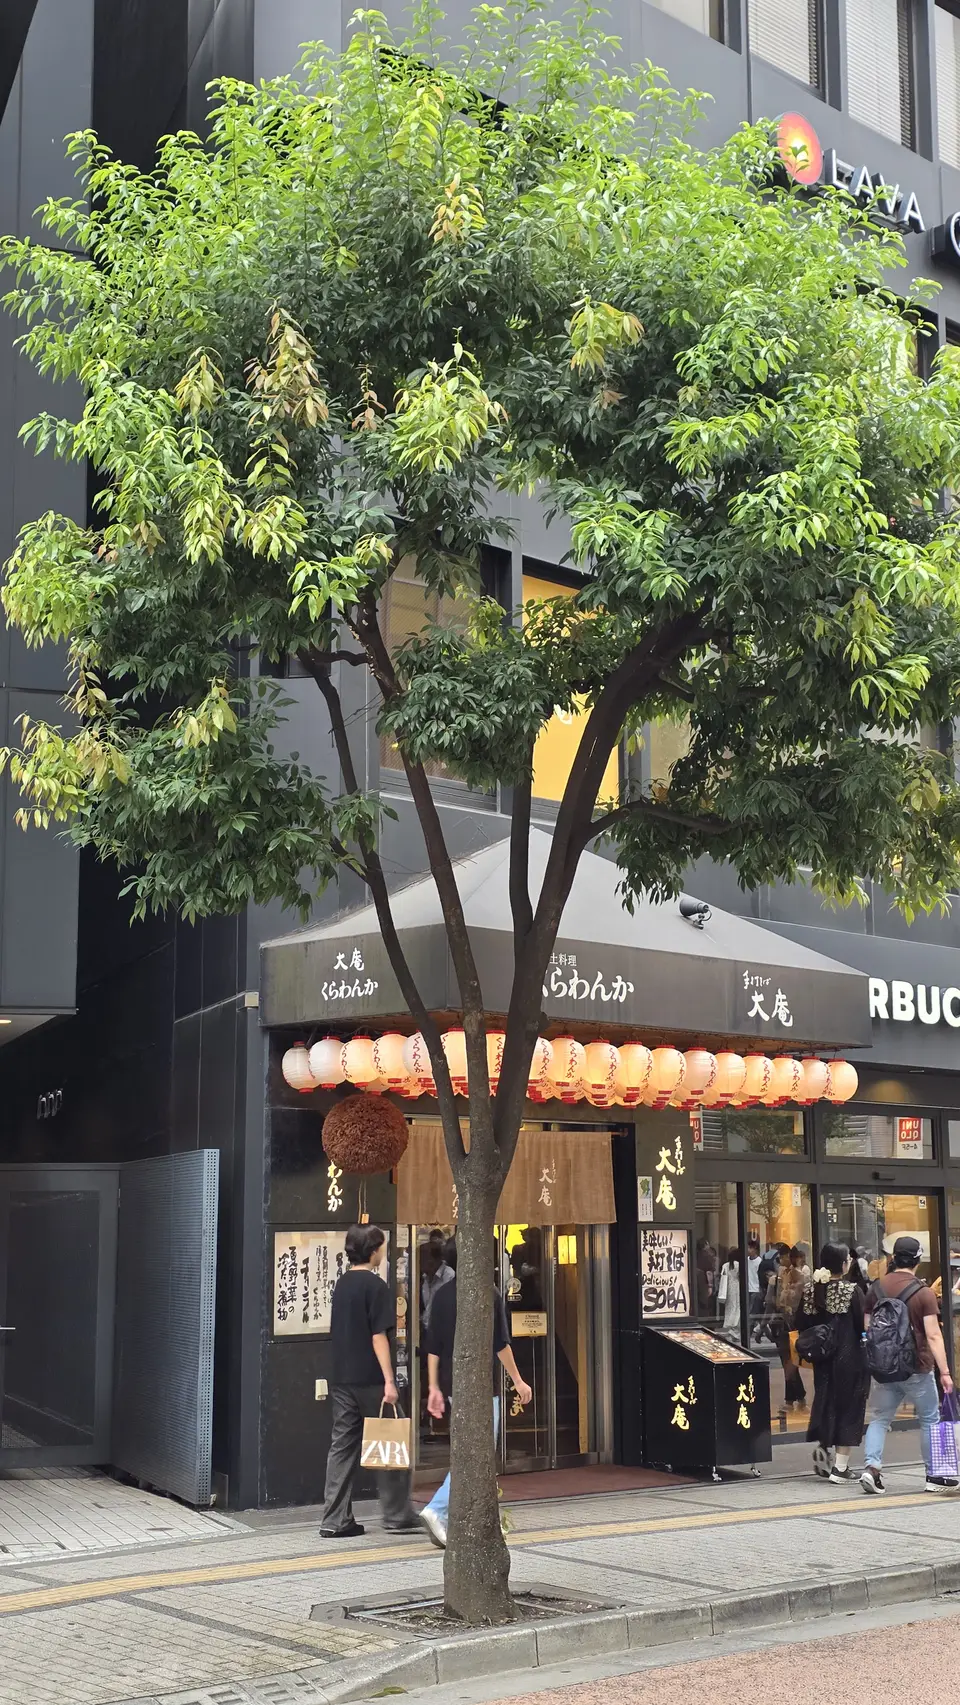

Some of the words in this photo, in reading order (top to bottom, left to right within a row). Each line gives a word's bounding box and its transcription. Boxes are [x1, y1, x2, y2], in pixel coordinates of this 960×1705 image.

[824, 148, 925, 232] LAVA
[333, 947, 365, 971] 大庵
[321, 978, 379, 1001] くらわんか
[747, 988, 794, 1027] 大庵
[412, 1036, 425, 1074] くらわんか
[565, 1042, 578, 1079] くらわんか
[538, 1168, 553, 1207] 大庵
[655, 1146, 677, 1211] 大庵
[643, 1284, 687, 1312] SOBA
[670, 1383, 690, 1430] 大庵
[736, 1383, 751, 1429] 大庵
[360, 1440, 410, 1465] ZARA
